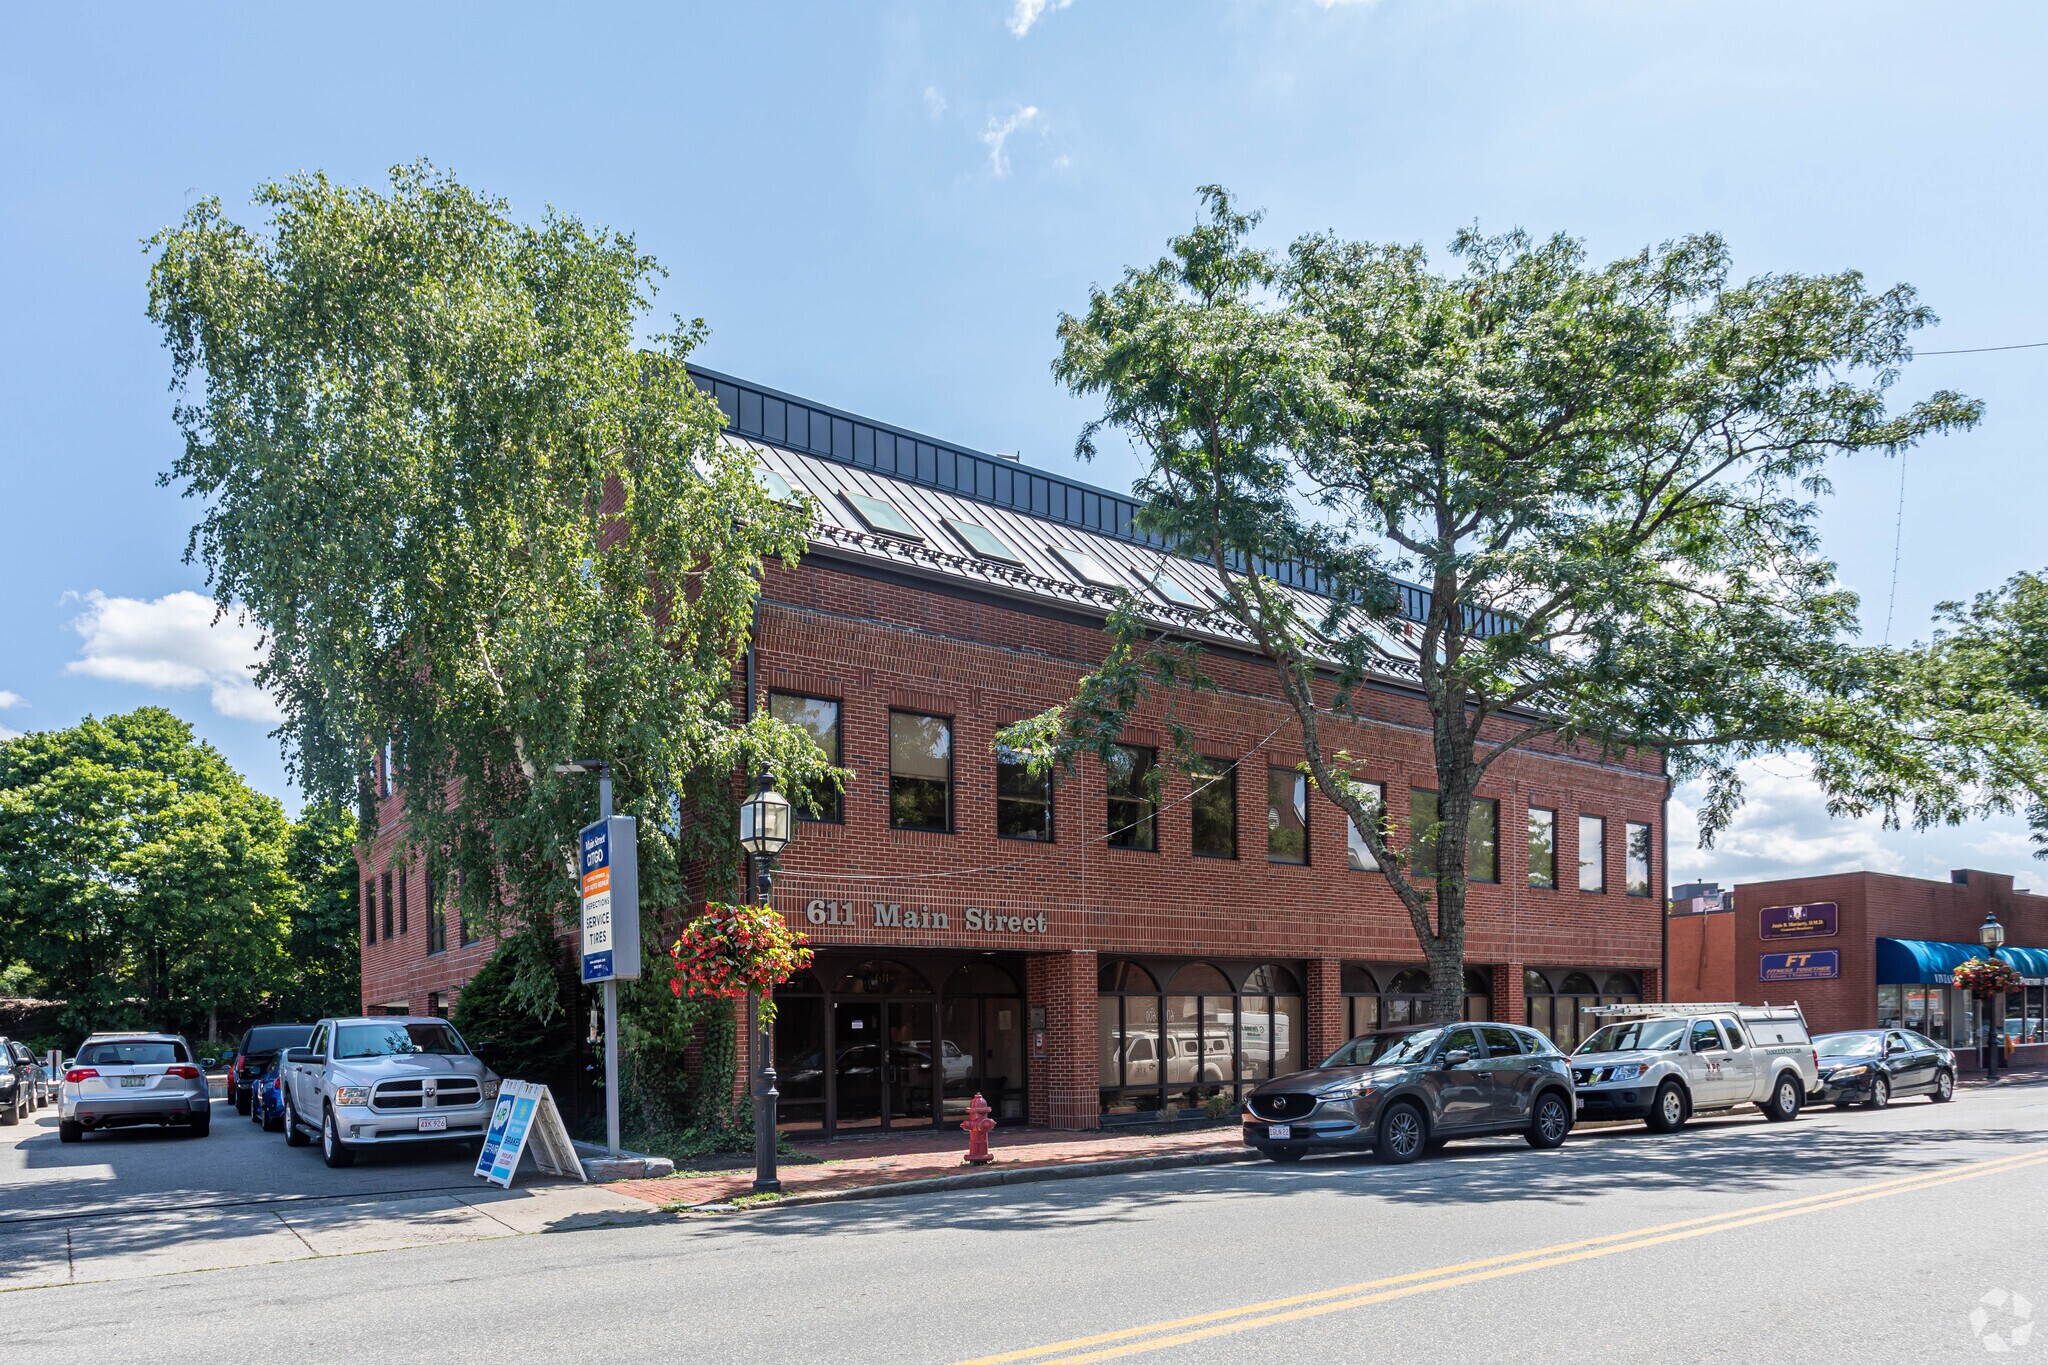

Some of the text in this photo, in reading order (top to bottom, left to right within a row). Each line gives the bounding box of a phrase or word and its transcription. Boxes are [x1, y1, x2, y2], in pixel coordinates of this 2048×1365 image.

[586, 848, 604, 867] CITGO
[586, 911, 610, 929] SERVICE
[805, 900, 1047, 933] 611 Main Street
[589, 930, 607, 945] TIRES
[1785, 954, 1812, 967] FT
